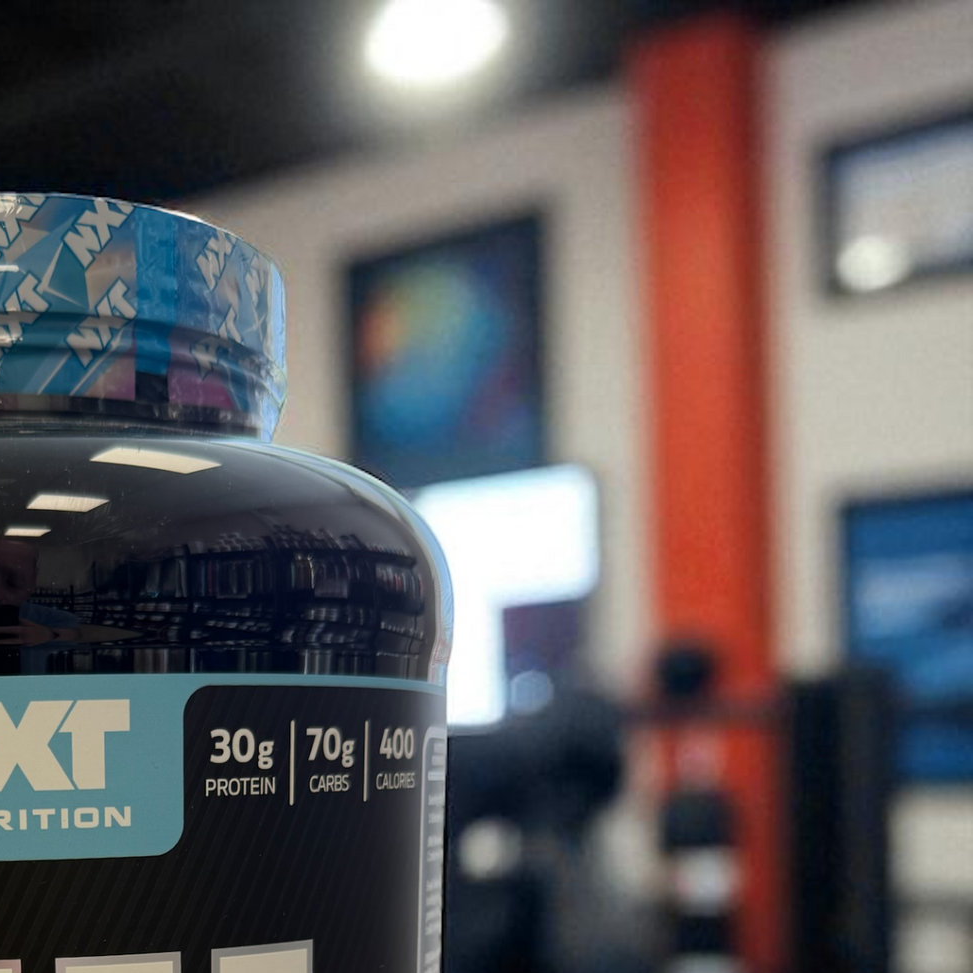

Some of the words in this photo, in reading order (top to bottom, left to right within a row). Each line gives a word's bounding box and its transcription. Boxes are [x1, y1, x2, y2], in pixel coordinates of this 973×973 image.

[64, 278, 138, 369] NXT
[209, 727, 275, 770] 30g
[306, 727, 356, 768] 70g
[379, 727, 416, 760] 400
[205, 776, 276, 797] PROTEIN
[309, 774, 350, 794] CARBS
[376, 772, 416, 791] CALORIES
